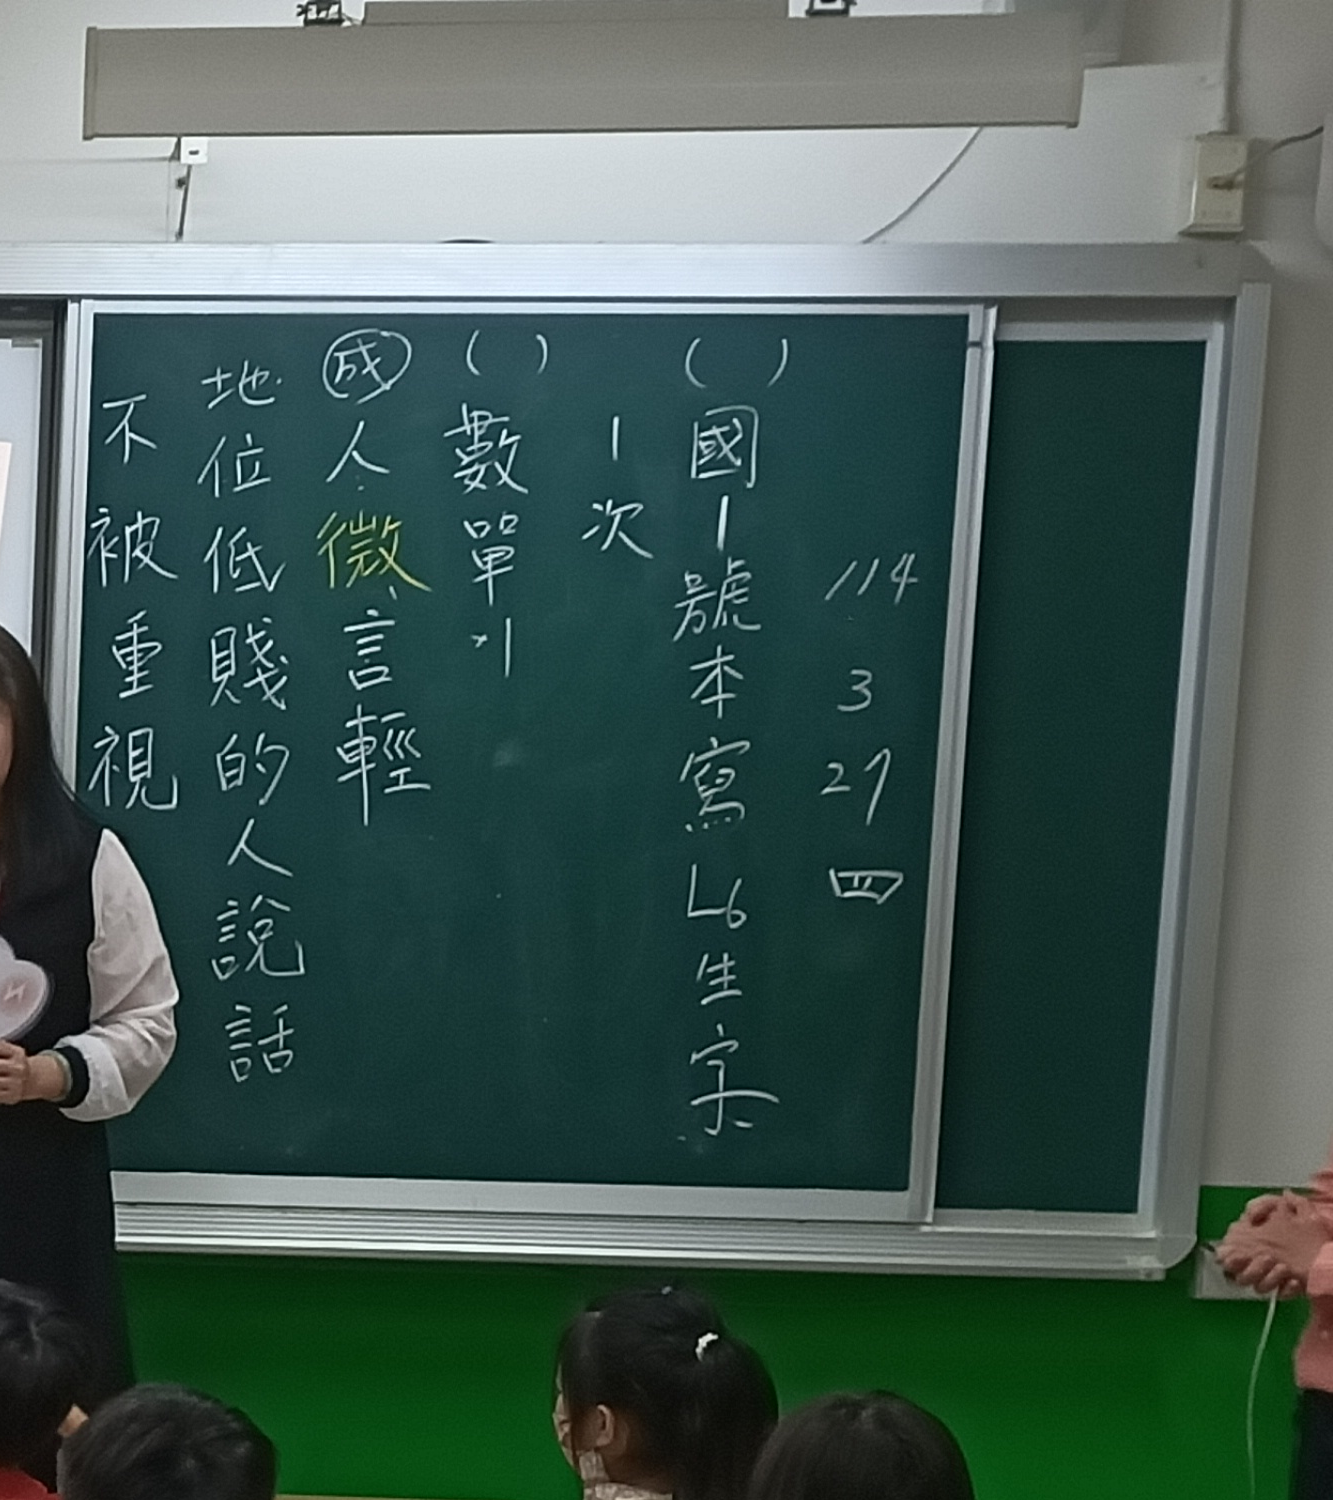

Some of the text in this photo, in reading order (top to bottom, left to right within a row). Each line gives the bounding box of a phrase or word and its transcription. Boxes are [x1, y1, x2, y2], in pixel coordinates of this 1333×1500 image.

[87, 394, 178, 811] 不被重視
[824, 552, 918, 604] 114
[837, 668, 873, 712] 3
[197, 360, 306, 1082] 地位低賤的人說話
[829, 868, 903, 904] 四
